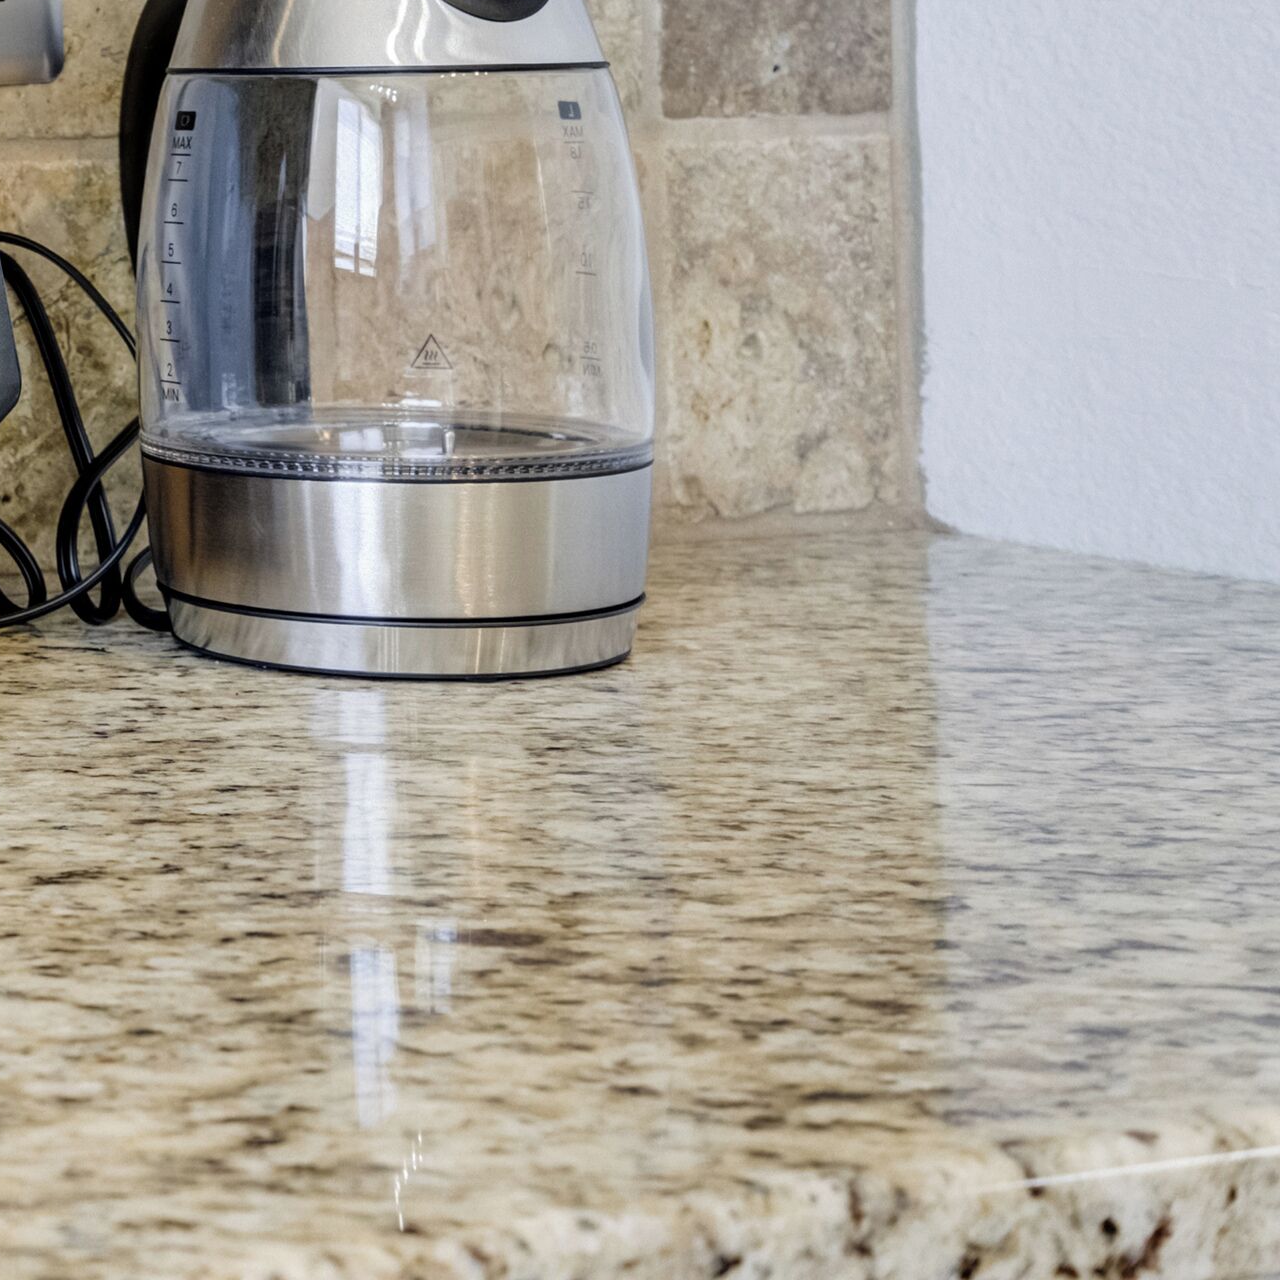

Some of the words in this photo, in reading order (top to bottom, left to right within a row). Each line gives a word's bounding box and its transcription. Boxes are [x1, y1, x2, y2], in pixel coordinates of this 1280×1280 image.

[171, 135, 193, 150] MAX
[176, 160, 182, 175] 7
[170, 203, 178, 218] 6
[167, 242, 175, 257] 5
[166, 282, 173, 296] 4
[166, 320, 173, 335] 3
[167, 362, 173, 377] 2
[161, 388, 180, 402] MIN
